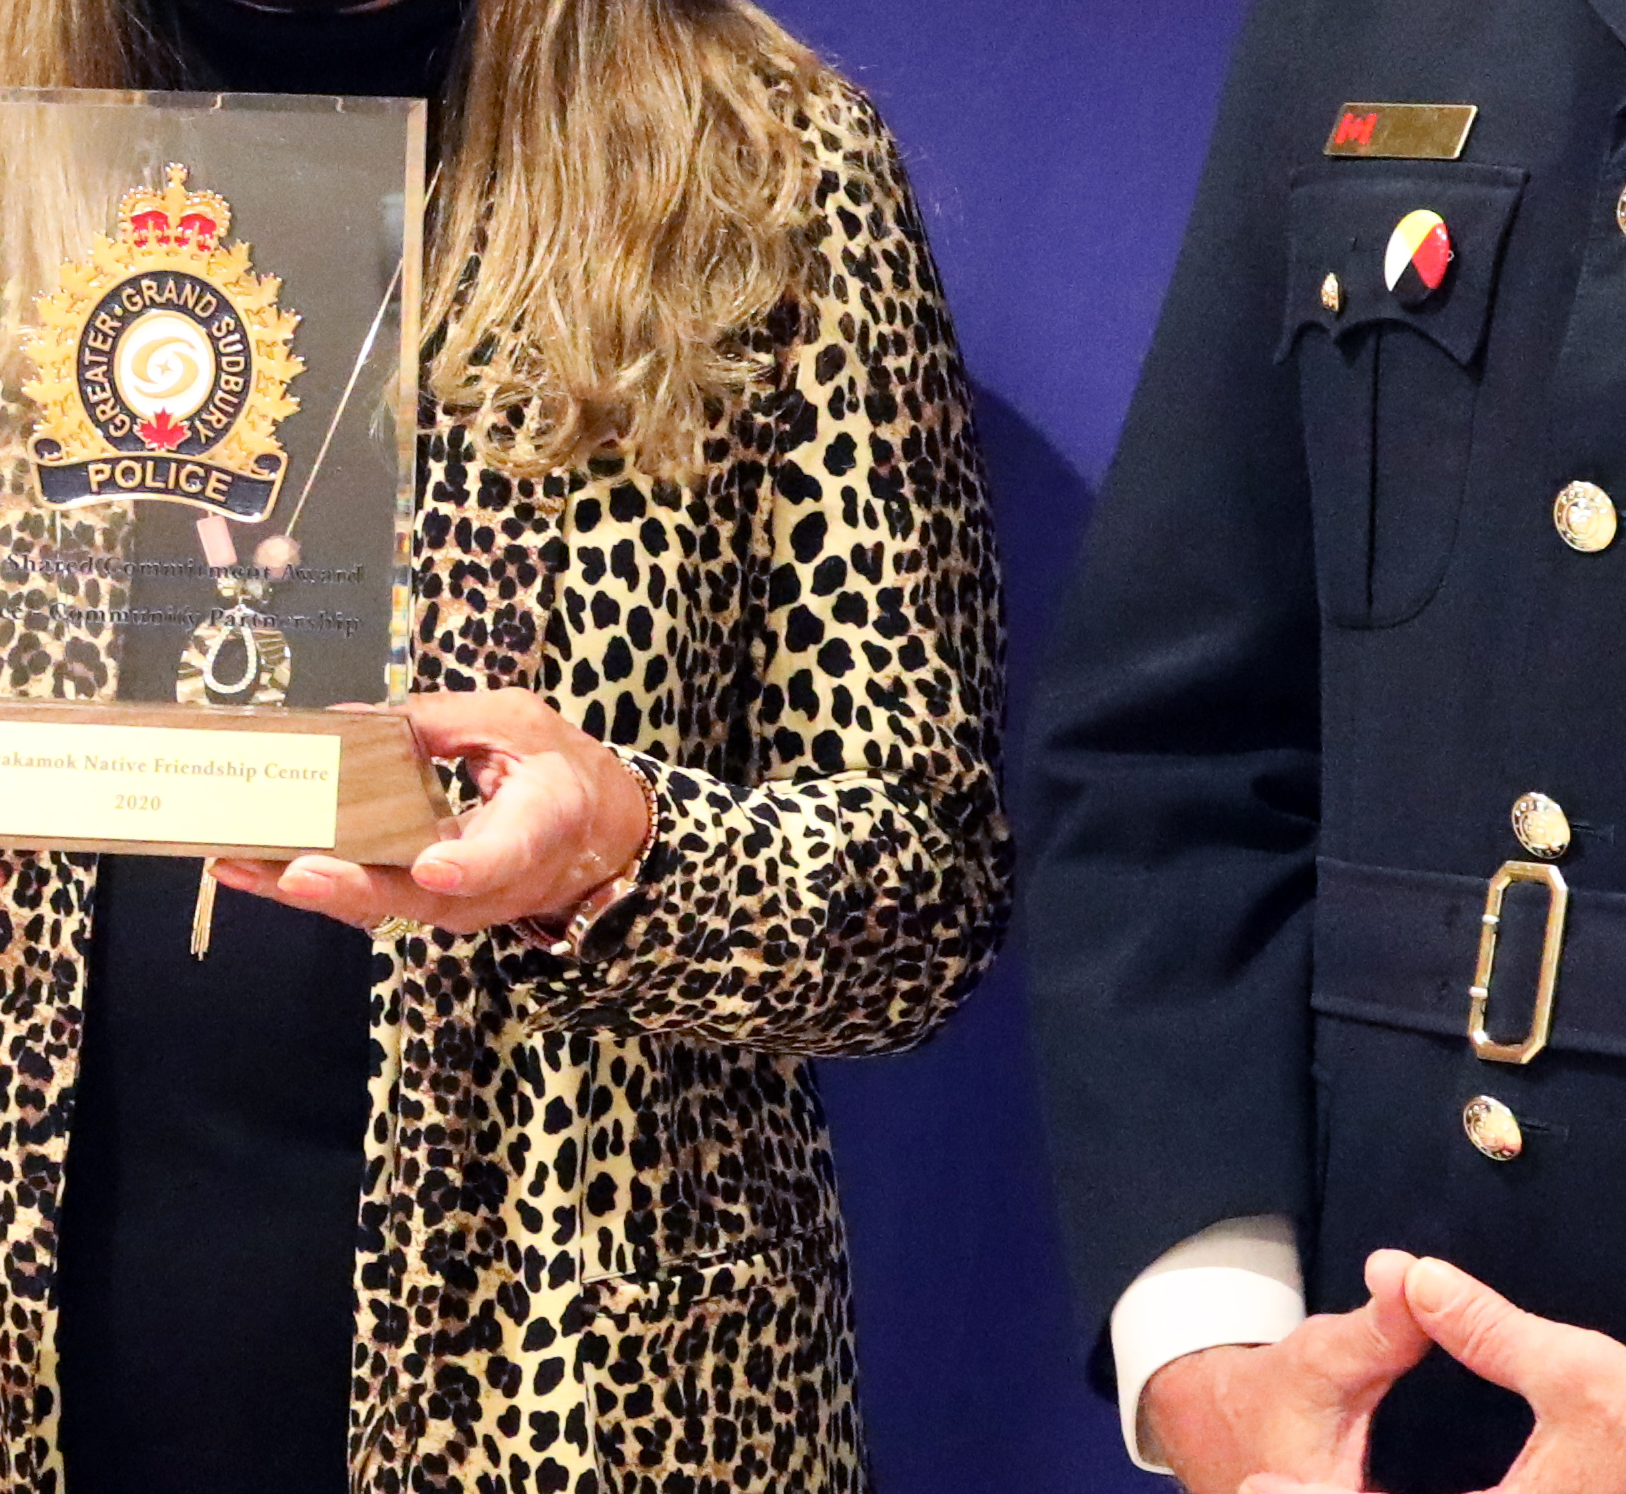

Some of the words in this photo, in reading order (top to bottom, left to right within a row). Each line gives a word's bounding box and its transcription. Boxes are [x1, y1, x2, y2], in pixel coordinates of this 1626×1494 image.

[83, 312, 132, 438] GREATER
[121, 277, 218, 318] GRAND
[195, 315, 246, 444] SUDBURY
[86, 458, 233, 503] POLICE
[7, 551, 94, 575] Shared
[102, 555, 271, 581] Commitment
[278, 561, 366, 584] Award
[48, 602, 200, 630] Community
[208, 606, 363, 636] Partnership
[84, 754, 148, 775] Native
[152, 755, 258, 783] Friendship
[264, 761, 330, 782] Centre
[114, 793, 163, 812] 2020
